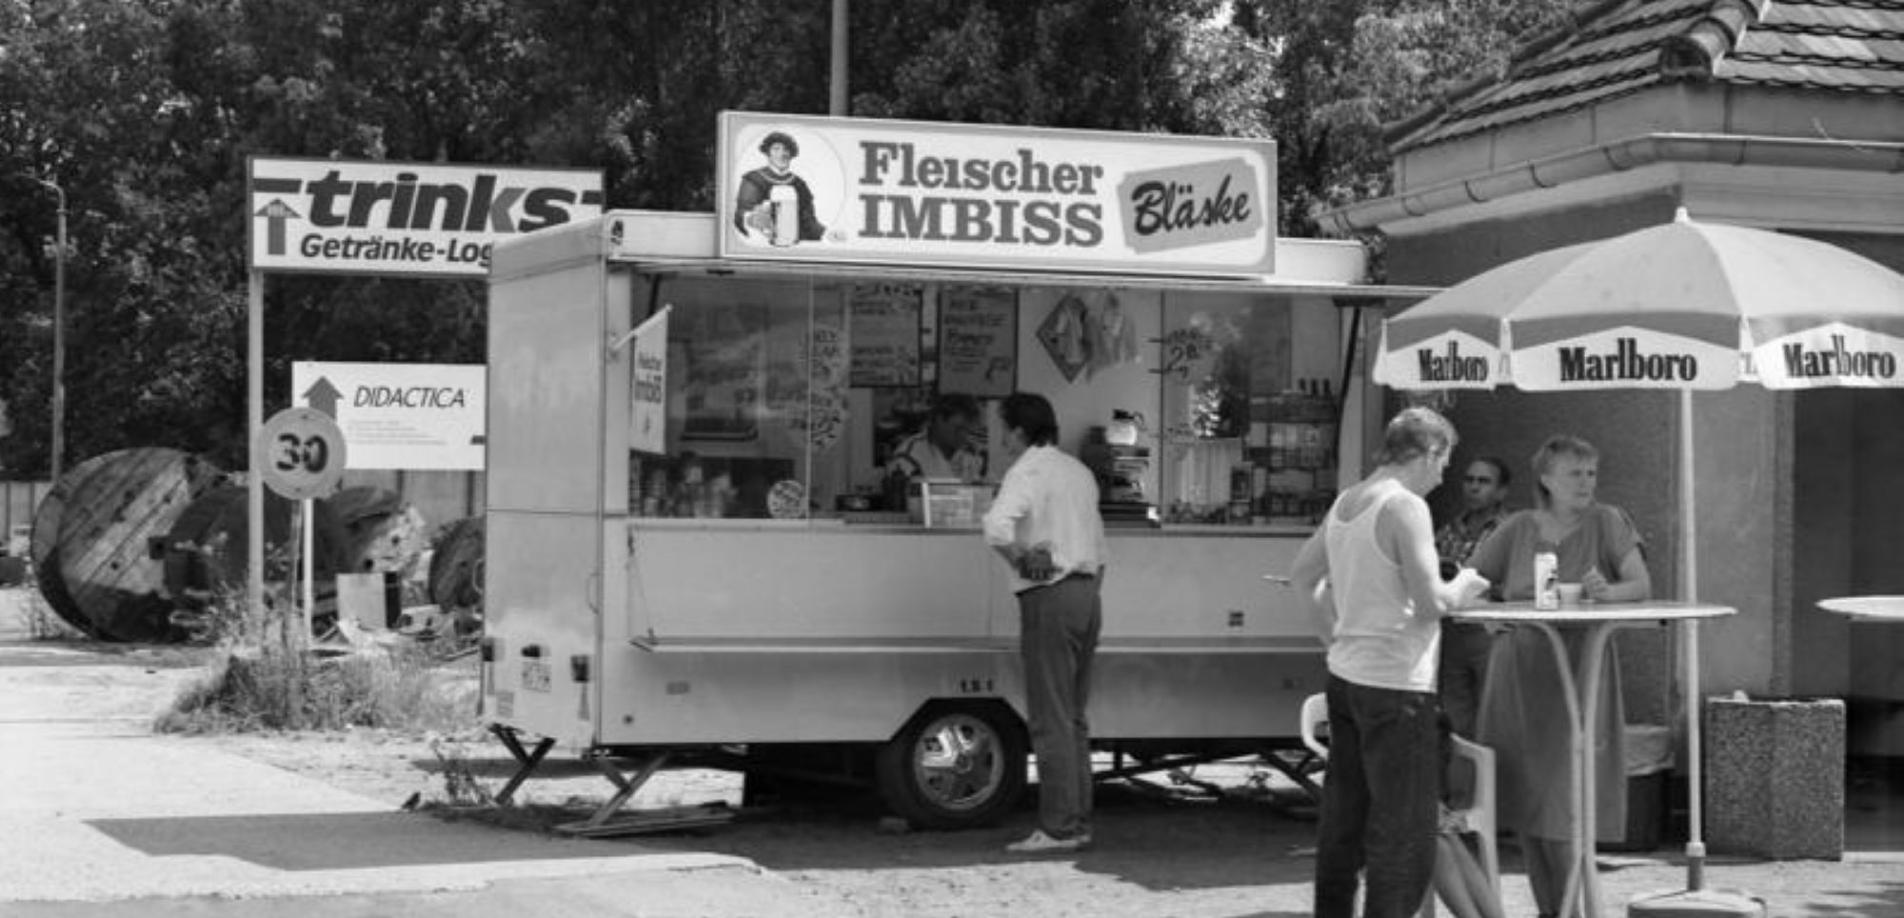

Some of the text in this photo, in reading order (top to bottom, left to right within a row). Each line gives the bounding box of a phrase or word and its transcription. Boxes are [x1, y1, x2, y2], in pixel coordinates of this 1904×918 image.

[859, 141, 1103, 194] Fleischer
[306, 170, 577, 232] trinks
[859, 195, 1103, 247] IMBISS
[1131, 175, 1250, 236] Bläske
[1559, 338, 1696, 382] Marlboro
[1783, 335, 1895, 379] Marlboro
[353, 386, 465, 408] DIDACTICA
[276, 433, 328, 473] 30
